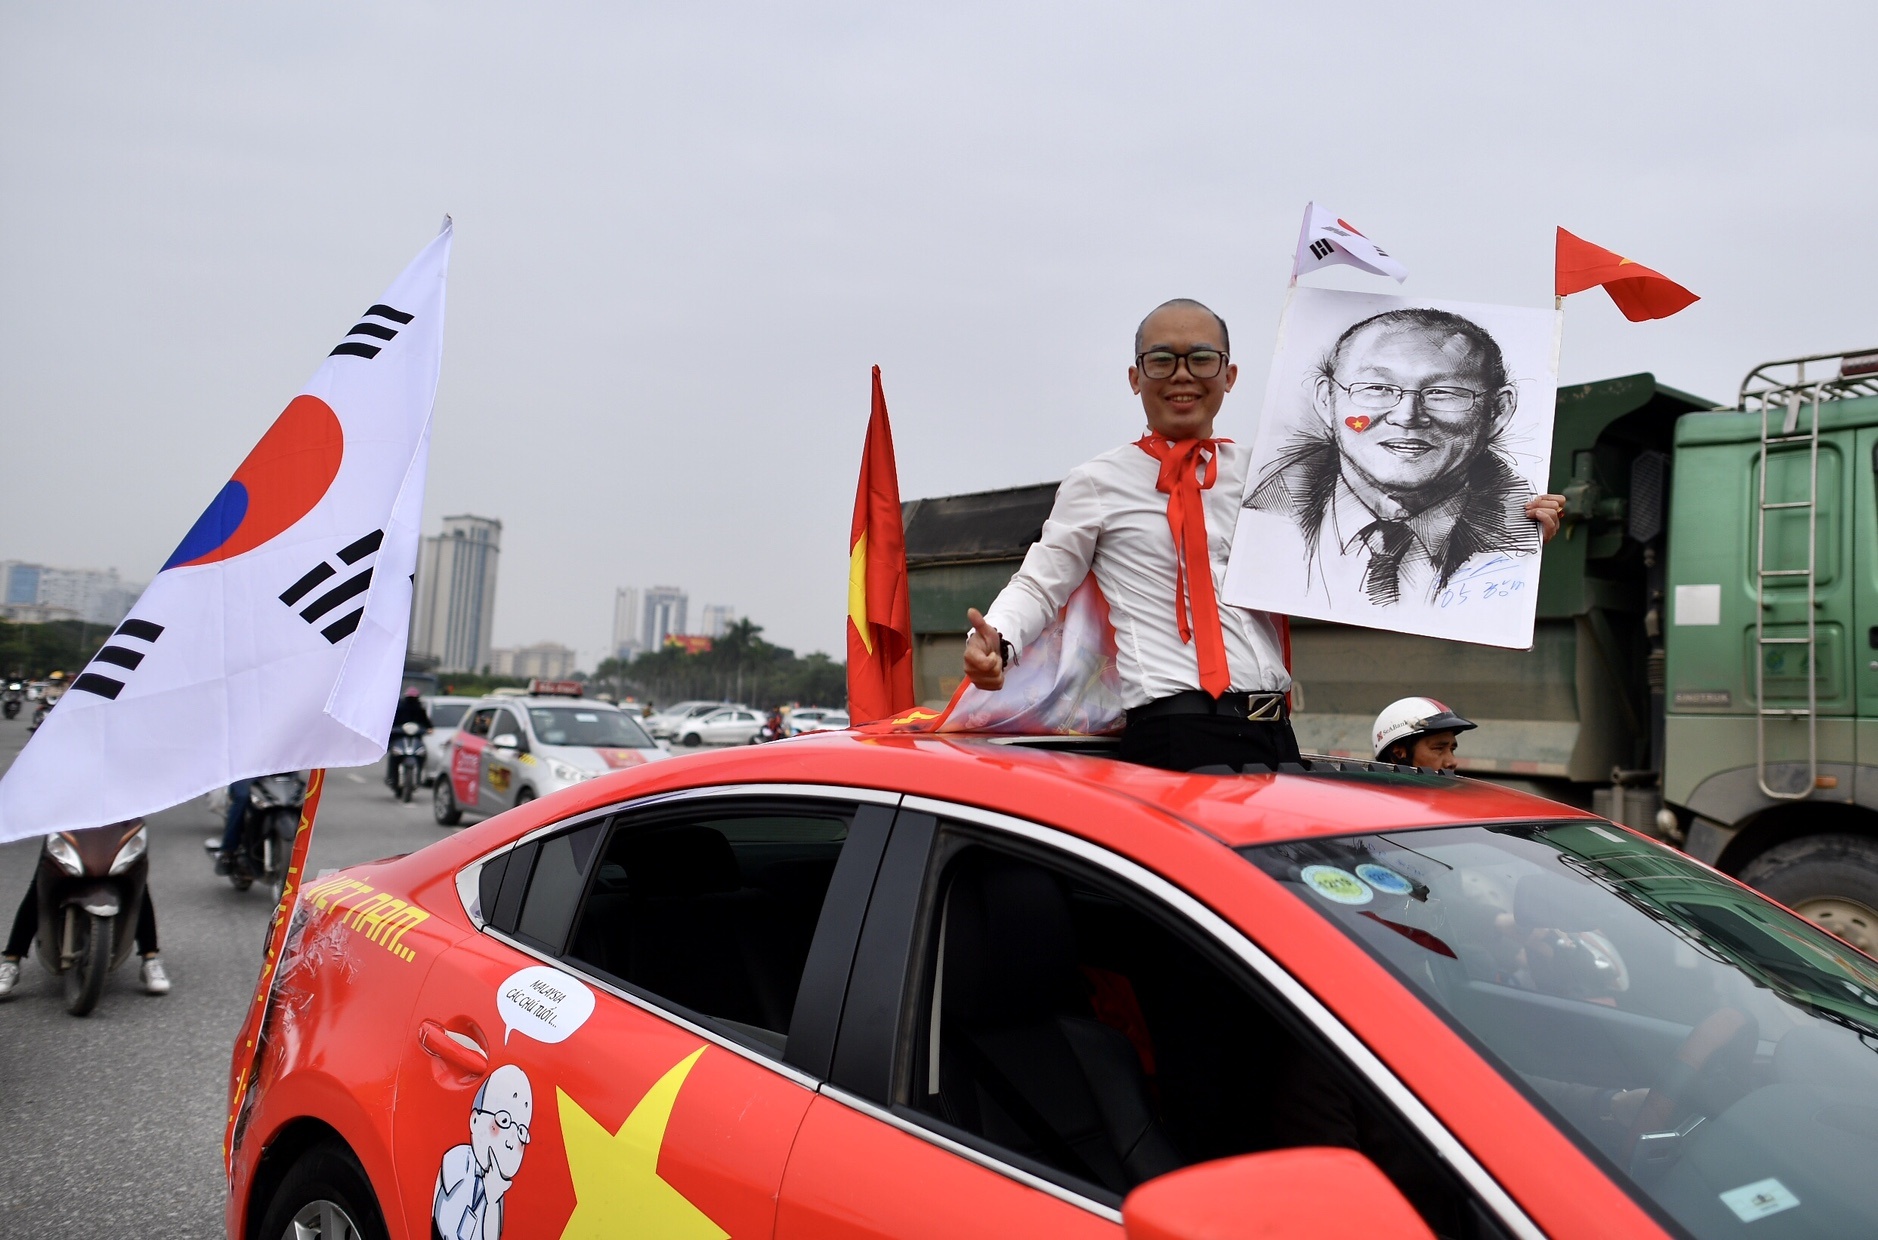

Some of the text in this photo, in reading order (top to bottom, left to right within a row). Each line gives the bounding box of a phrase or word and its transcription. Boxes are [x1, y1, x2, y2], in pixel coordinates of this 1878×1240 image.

[1382, 719, 1408, 736] SeABank
[505, 988, 525, 1004] CÁC
[518, 996, 541, 1013] CHÚ
[529, 979, 567, 1004] MALAYSIA
